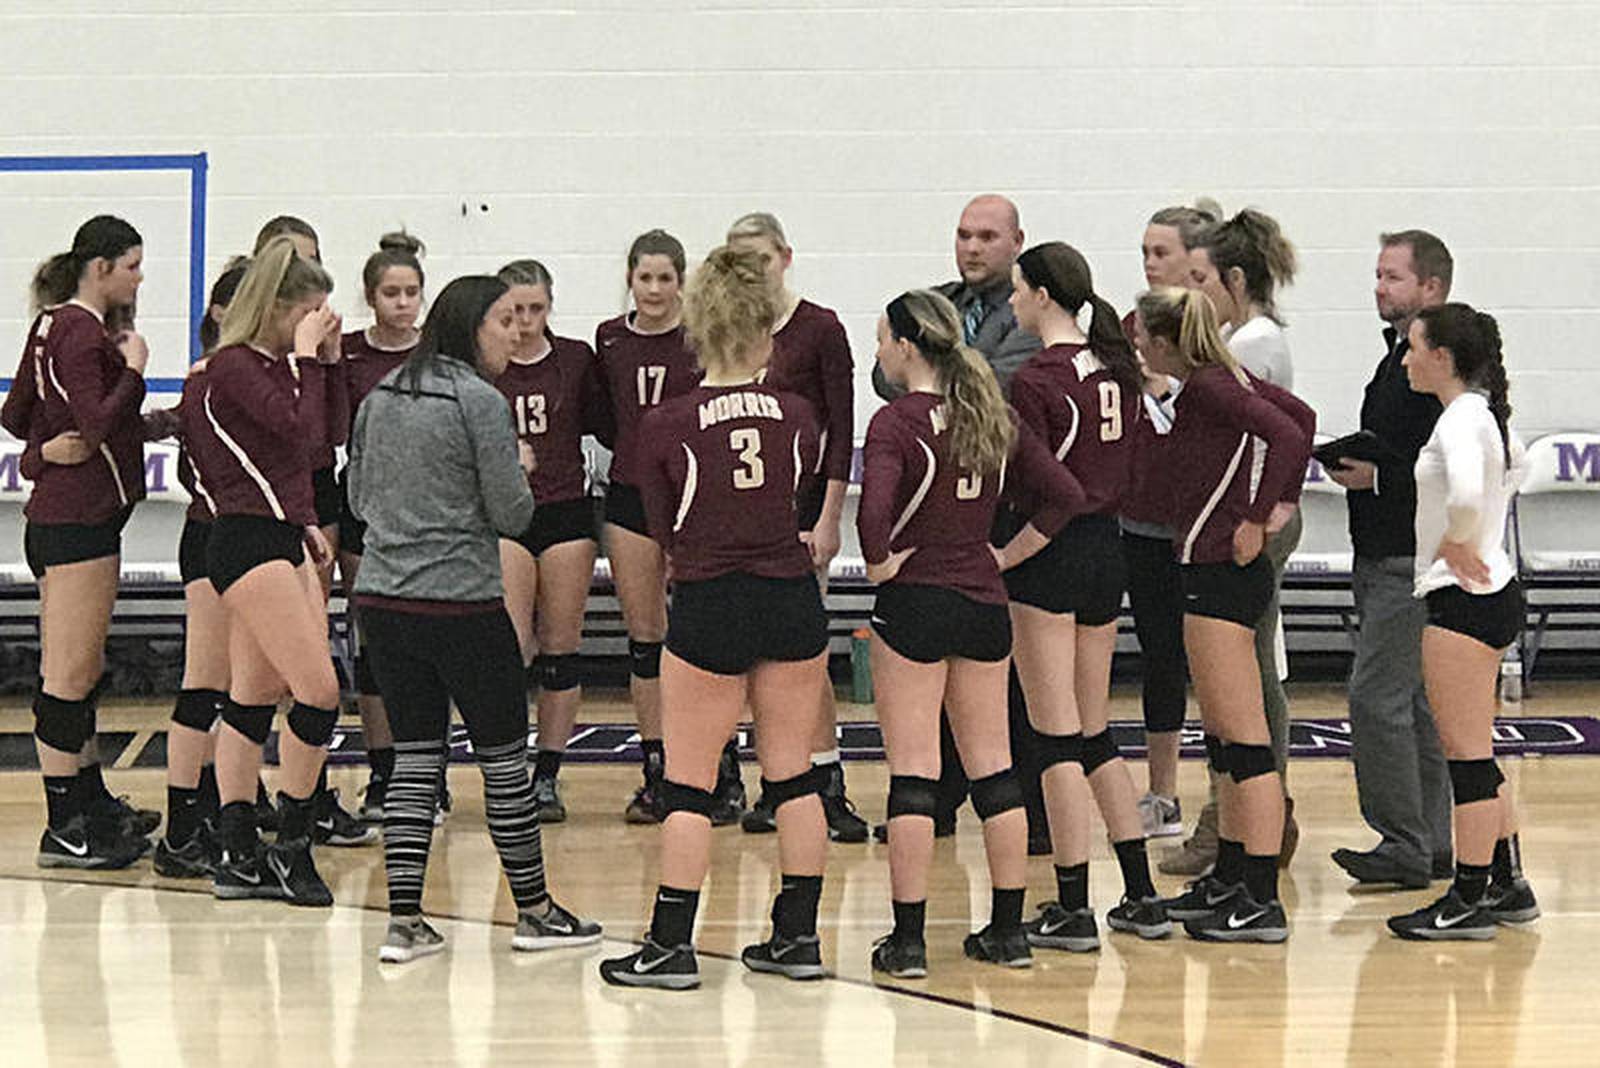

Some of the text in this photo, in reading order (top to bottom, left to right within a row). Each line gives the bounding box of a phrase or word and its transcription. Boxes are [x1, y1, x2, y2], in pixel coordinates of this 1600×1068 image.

[637, 366, 667, 405] 17
[515, 394, 547, 435] 13
[699, 392, 783, 430] MORRIS
[1098, 381, 1122, 441] 9
[730, 428, 765, 489] 3
[1553, 443, 1600, 482] M
